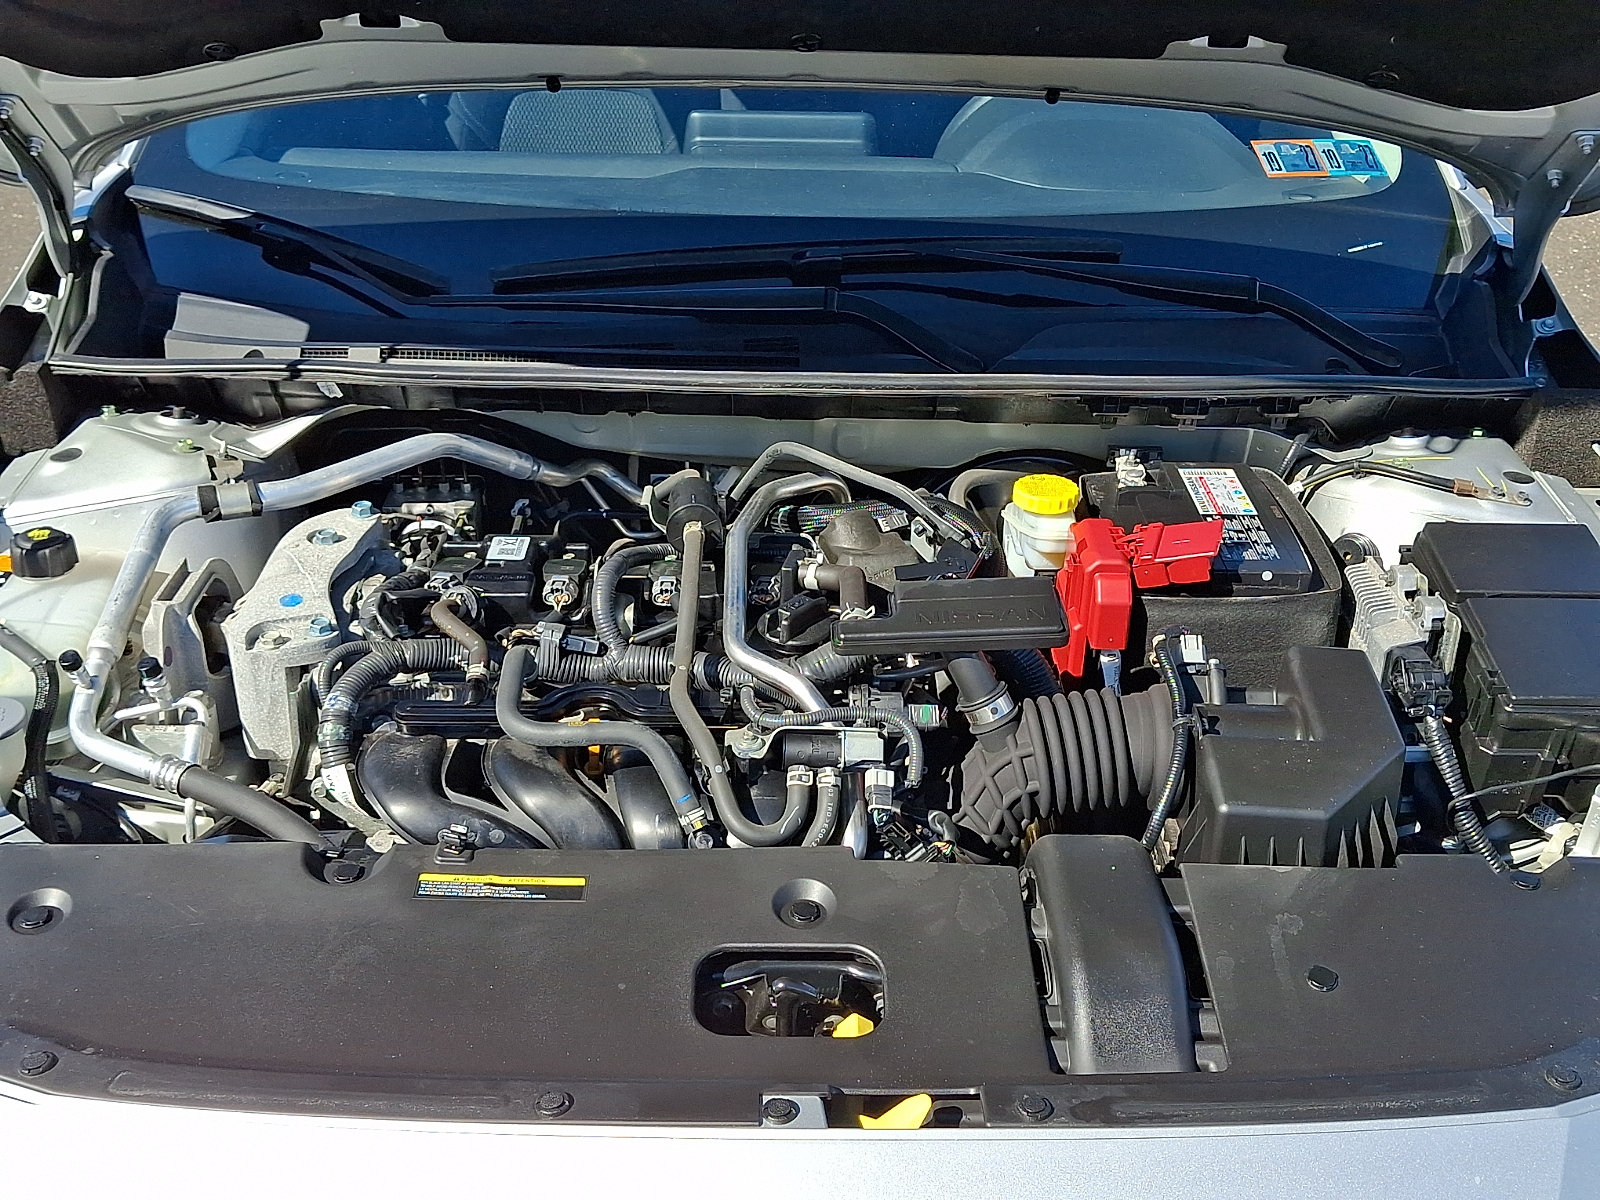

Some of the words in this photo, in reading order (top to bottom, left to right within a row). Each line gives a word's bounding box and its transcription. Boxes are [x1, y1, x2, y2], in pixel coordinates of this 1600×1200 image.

[1262, 151, 1282, 171] 10
[1321, 148, 1341, 169] 10
[915, 606, 1046, 625] NISSAN
